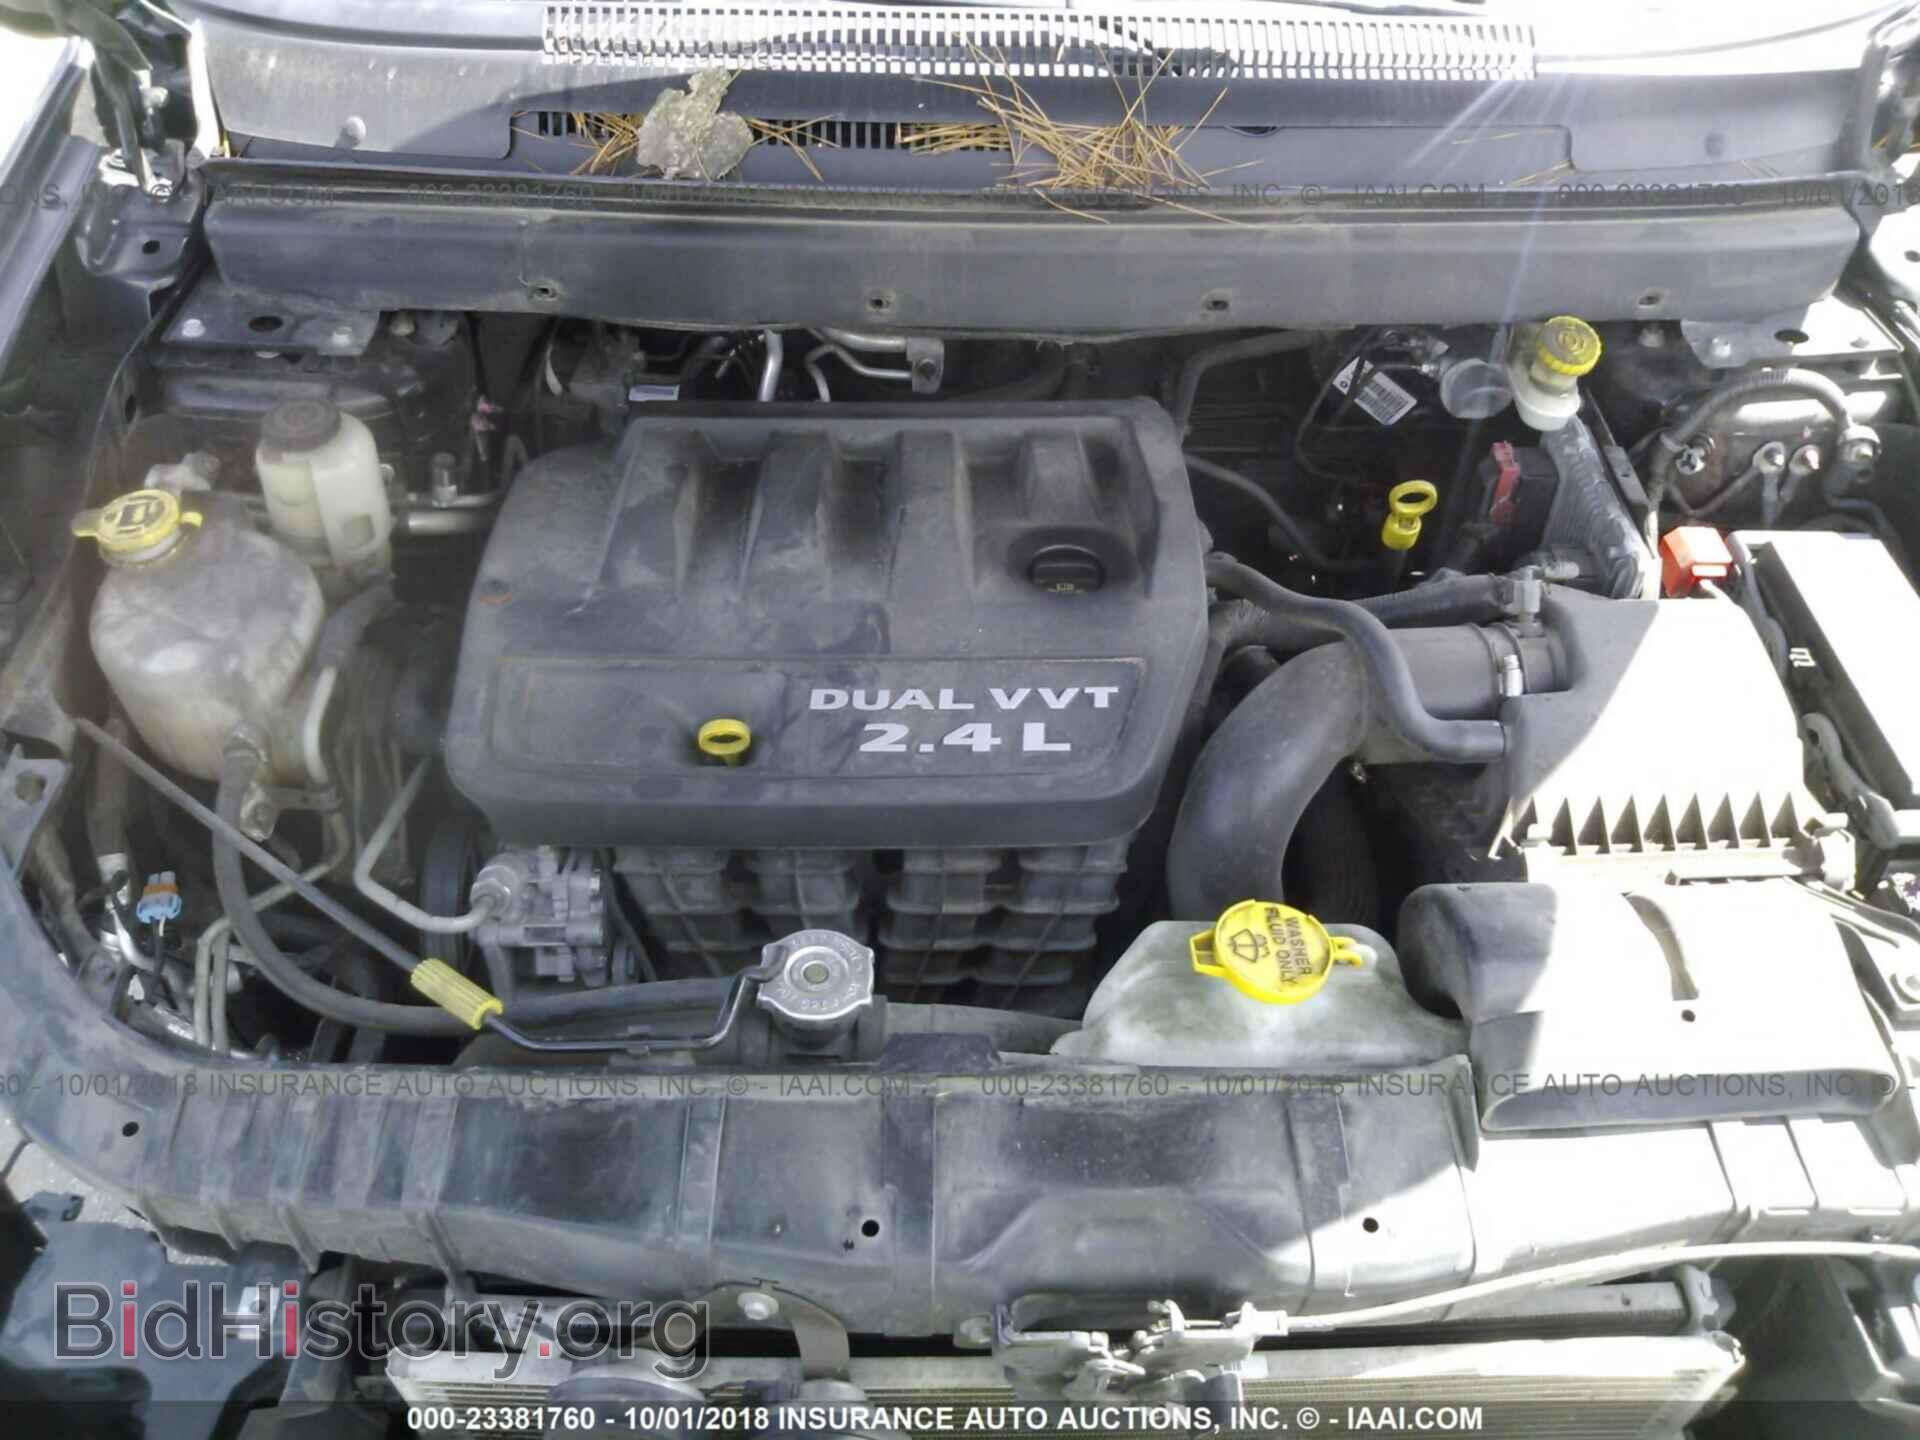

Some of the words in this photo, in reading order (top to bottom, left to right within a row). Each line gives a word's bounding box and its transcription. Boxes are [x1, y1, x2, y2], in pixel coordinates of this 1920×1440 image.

[809, 688, 975, 711] DUAL
[990, 687, 1119, 710] VVT
[1265, 907, 1286, 945] FLUID
[1285, 916, 1312, 975] WASHER
[1275, 950, 1298, 985] ONLY
